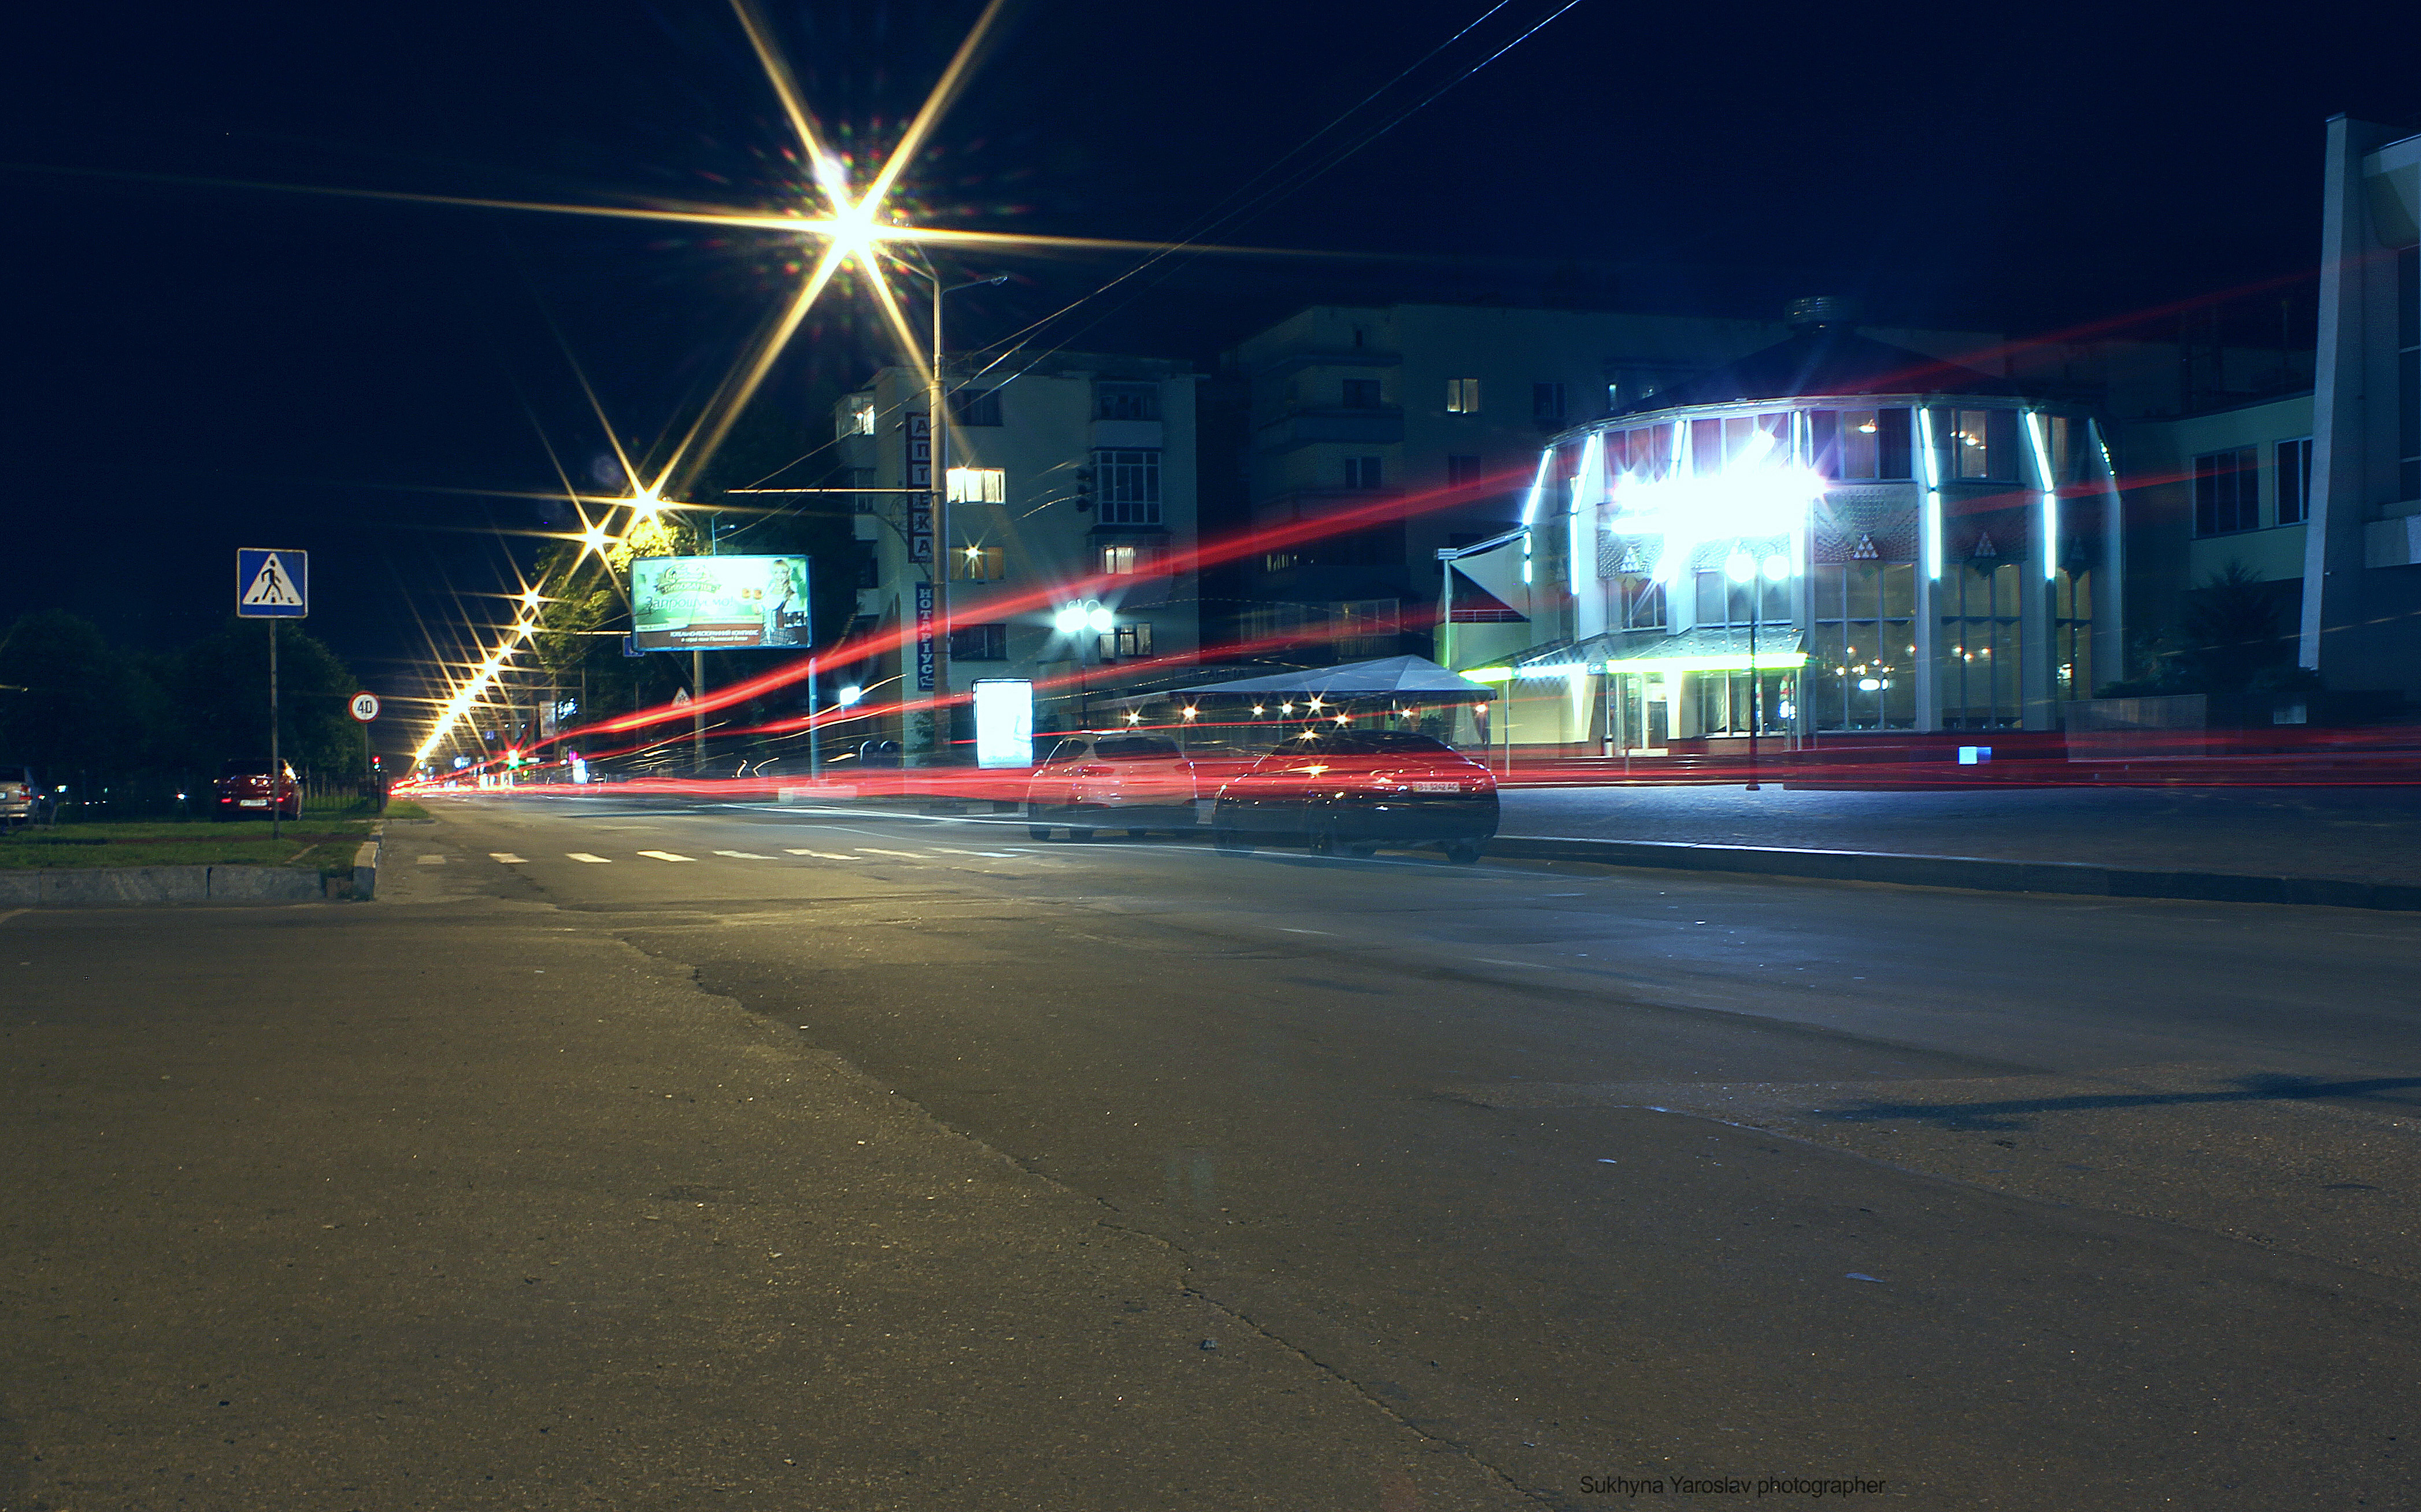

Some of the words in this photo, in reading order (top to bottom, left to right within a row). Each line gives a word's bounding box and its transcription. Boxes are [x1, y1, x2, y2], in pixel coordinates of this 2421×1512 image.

[916, 421, 931, 554] АПТЕКА
[919, 589, 934, 675] НОТАРІУС
[357, 701, 372, 713] 40
